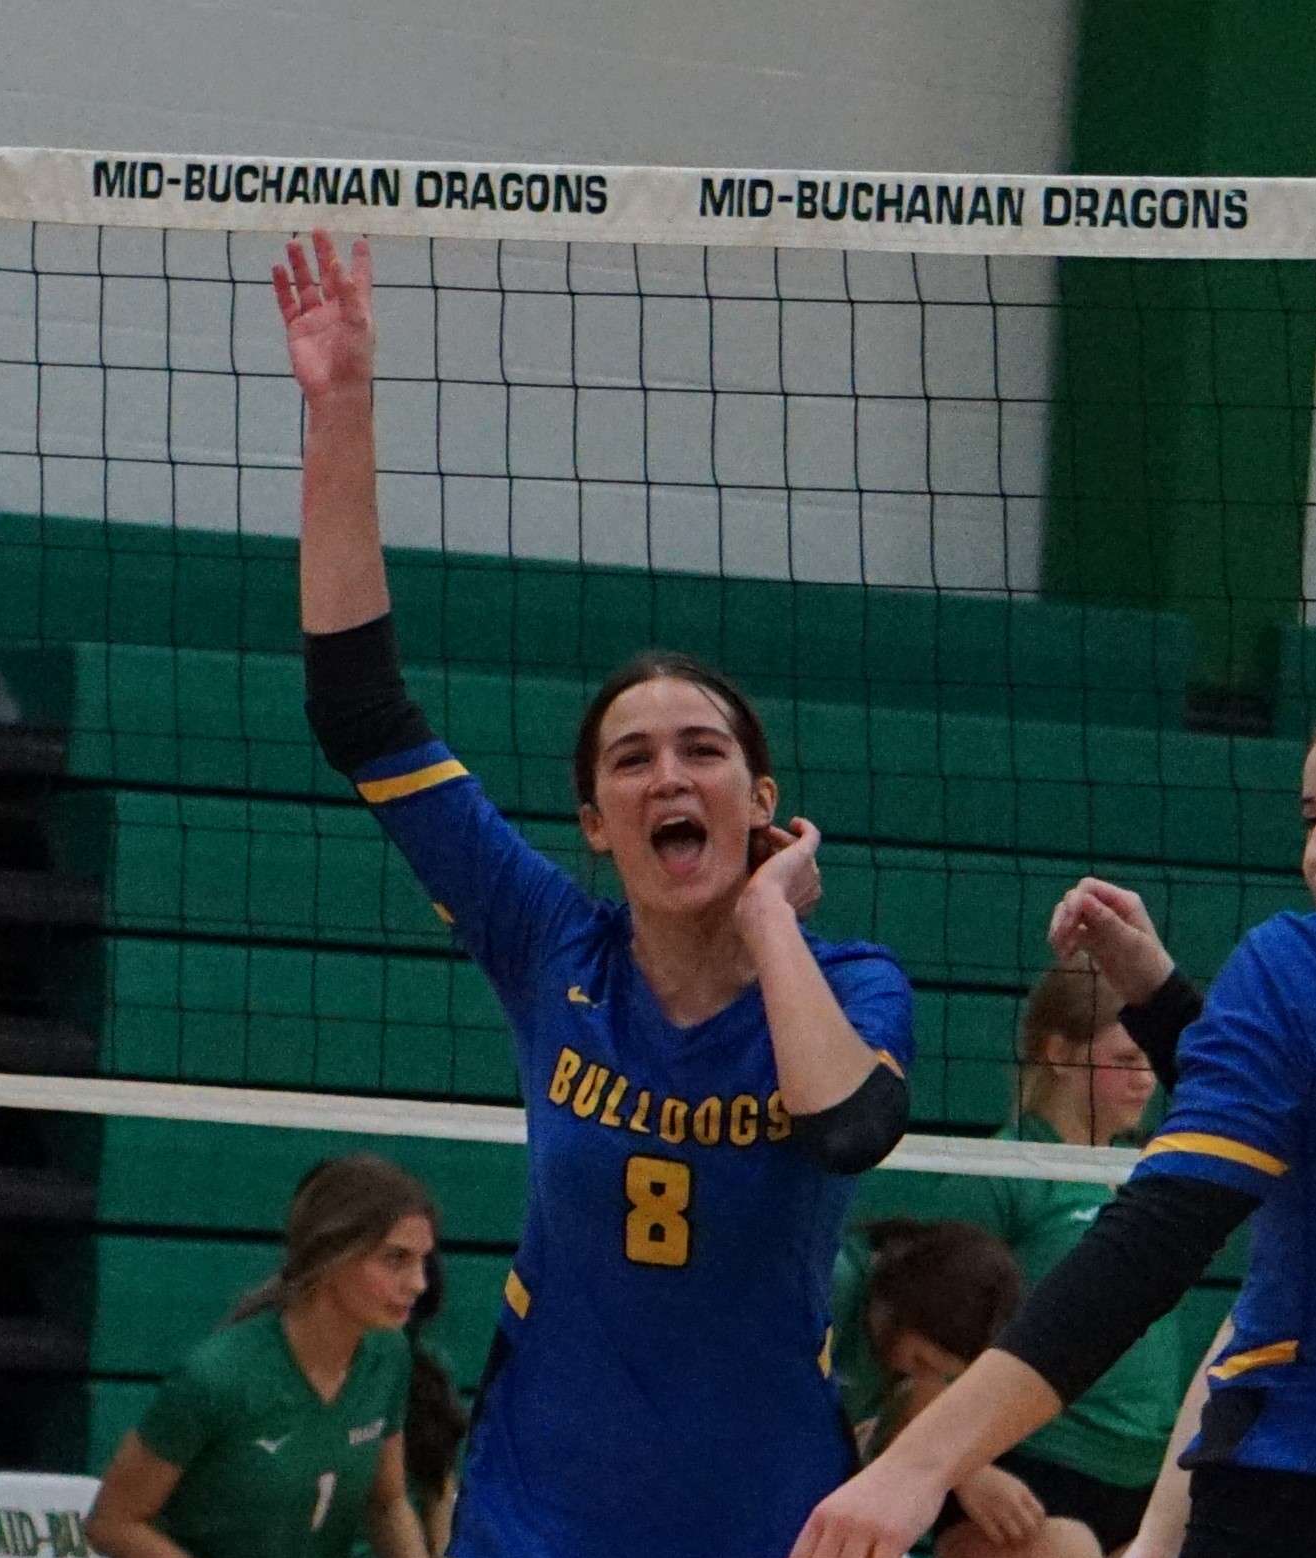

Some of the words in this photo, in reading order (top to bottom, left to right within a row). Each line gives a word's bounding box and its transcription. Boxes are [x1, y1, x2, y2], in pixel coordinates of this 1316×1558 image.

[92, 159, 401, 208] MID-BUCHANAN
[414, 169, 609, 216] DRAGONS
[697, 177, 1026, 228] MID-BUCHANAN
[1042, 186, 1250, 231] DRAGONS
[548, 1045, 793, 1148] BULLDOGS
[625, 1155, 692, 1267] 8
[310, 1470, 337, 1533] 1
